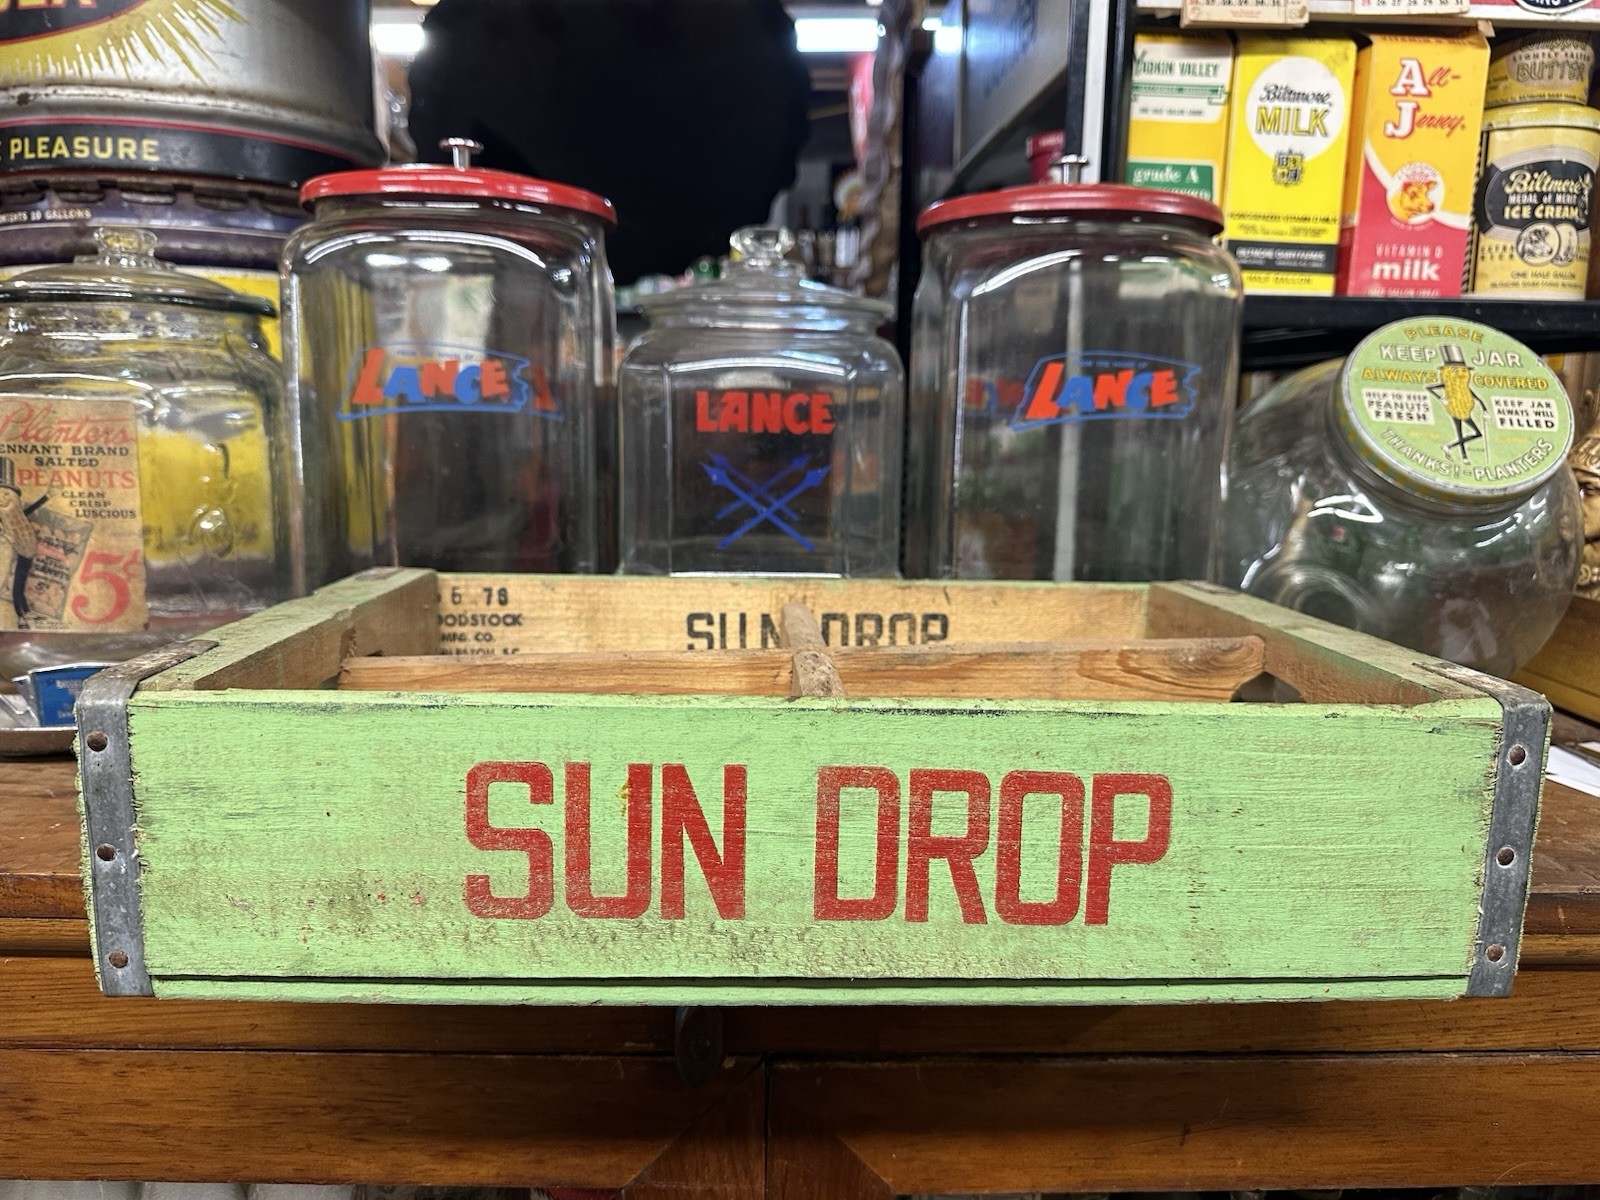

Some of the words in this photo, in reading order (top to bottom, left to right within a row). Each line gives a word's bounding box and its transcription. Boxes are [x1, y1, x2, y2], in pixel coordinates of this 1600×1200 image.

[1179, 62, 1218, 77] VALLEY
[1255, 105, 1329, 137] MILK
[9, 135, 160, 162] PLEASURE
[1185, 166, 1200, 184] A
[1504, 169, 1582, 195] Biltmore
[1503, 204, 1532, 220] ICE
[1534, 204, 1580, 220] CREAM
[1375, 243, 1431, 258] VITAMIN
[1372, 259, 1440, 281] milk
[1404, 324, 1484, 343] PLEASE
[1380, 344, 1438, 363] KEEP
[1472, 349, 1524, 368] JAR
[351, 347, 510, 404] LANCE
[1362, 366, 1439, 384] ALWAYS
[1473, 373, 1549, 391] COVERED
[1025, 362, 1178, 420] LANCE
[695, 390, 836, 435] LANCE
[1367, 401, 1430, 412] PEANUTS
[1494, 400, 1524, 408] KEEP
[1497, 409, 1530, 417] ALWAYS
[0, 400, 136, 446] Planters
[1375, 411, 1428, 421] FRESH
[1499, 418, 1556, 429] FILLED
[0, 444, 62, 455] ENNANT
[71, 446, 129, 456] BRAND
[34, 457, 99, 468] SALTED
[1473, 438, 1554, 481] PLANTERS
[17, 468, 137, 489] PEANUTS
[61, 490, 106, 499] CLEAN
[69, 499, 111, 508] CRISP
[75, 508, 137, 519] LUSCIOUS
[483, 586, 508, 606] 78
[438, 613, 523, 628] ODSTOCK
[464, 760, 748, 920] SUN
[813, 765, 1174, 926] DROP
